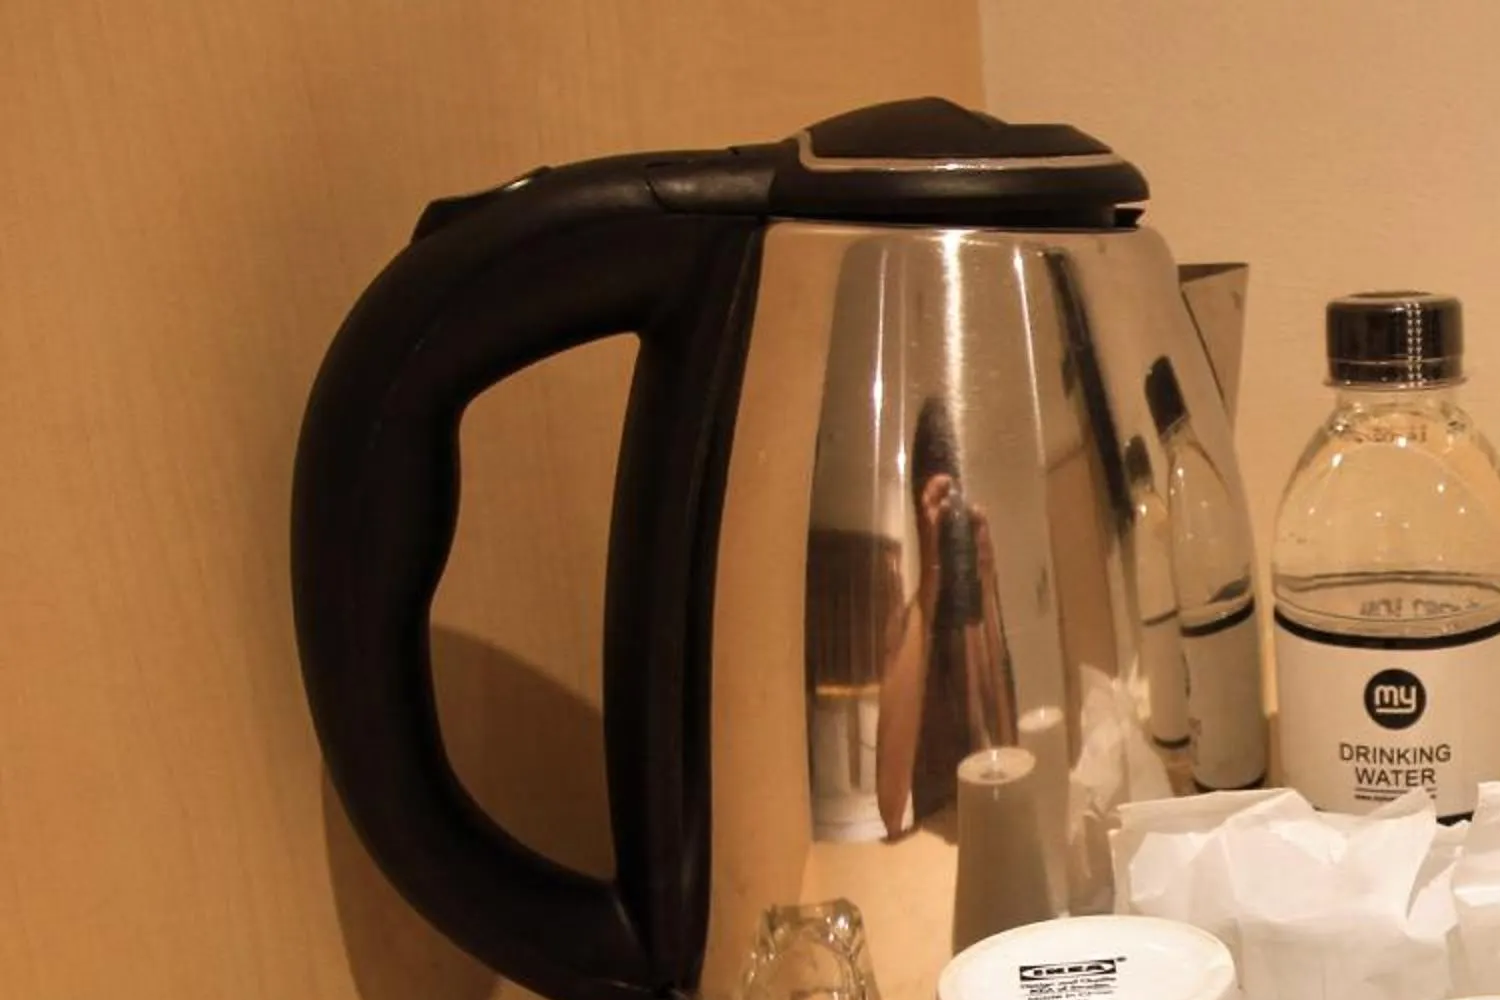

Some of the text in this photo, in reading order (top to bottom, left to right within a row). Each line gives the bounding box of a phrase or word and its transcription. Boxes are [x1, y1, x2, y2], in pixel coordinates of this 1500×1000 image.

[1374, 684, 1417, 714] my
[1339, 742, 1452, 765] DRINKING
[1354, 766, 1436, 787] WATER
[1030, 961, 1110, 978] IKEA
